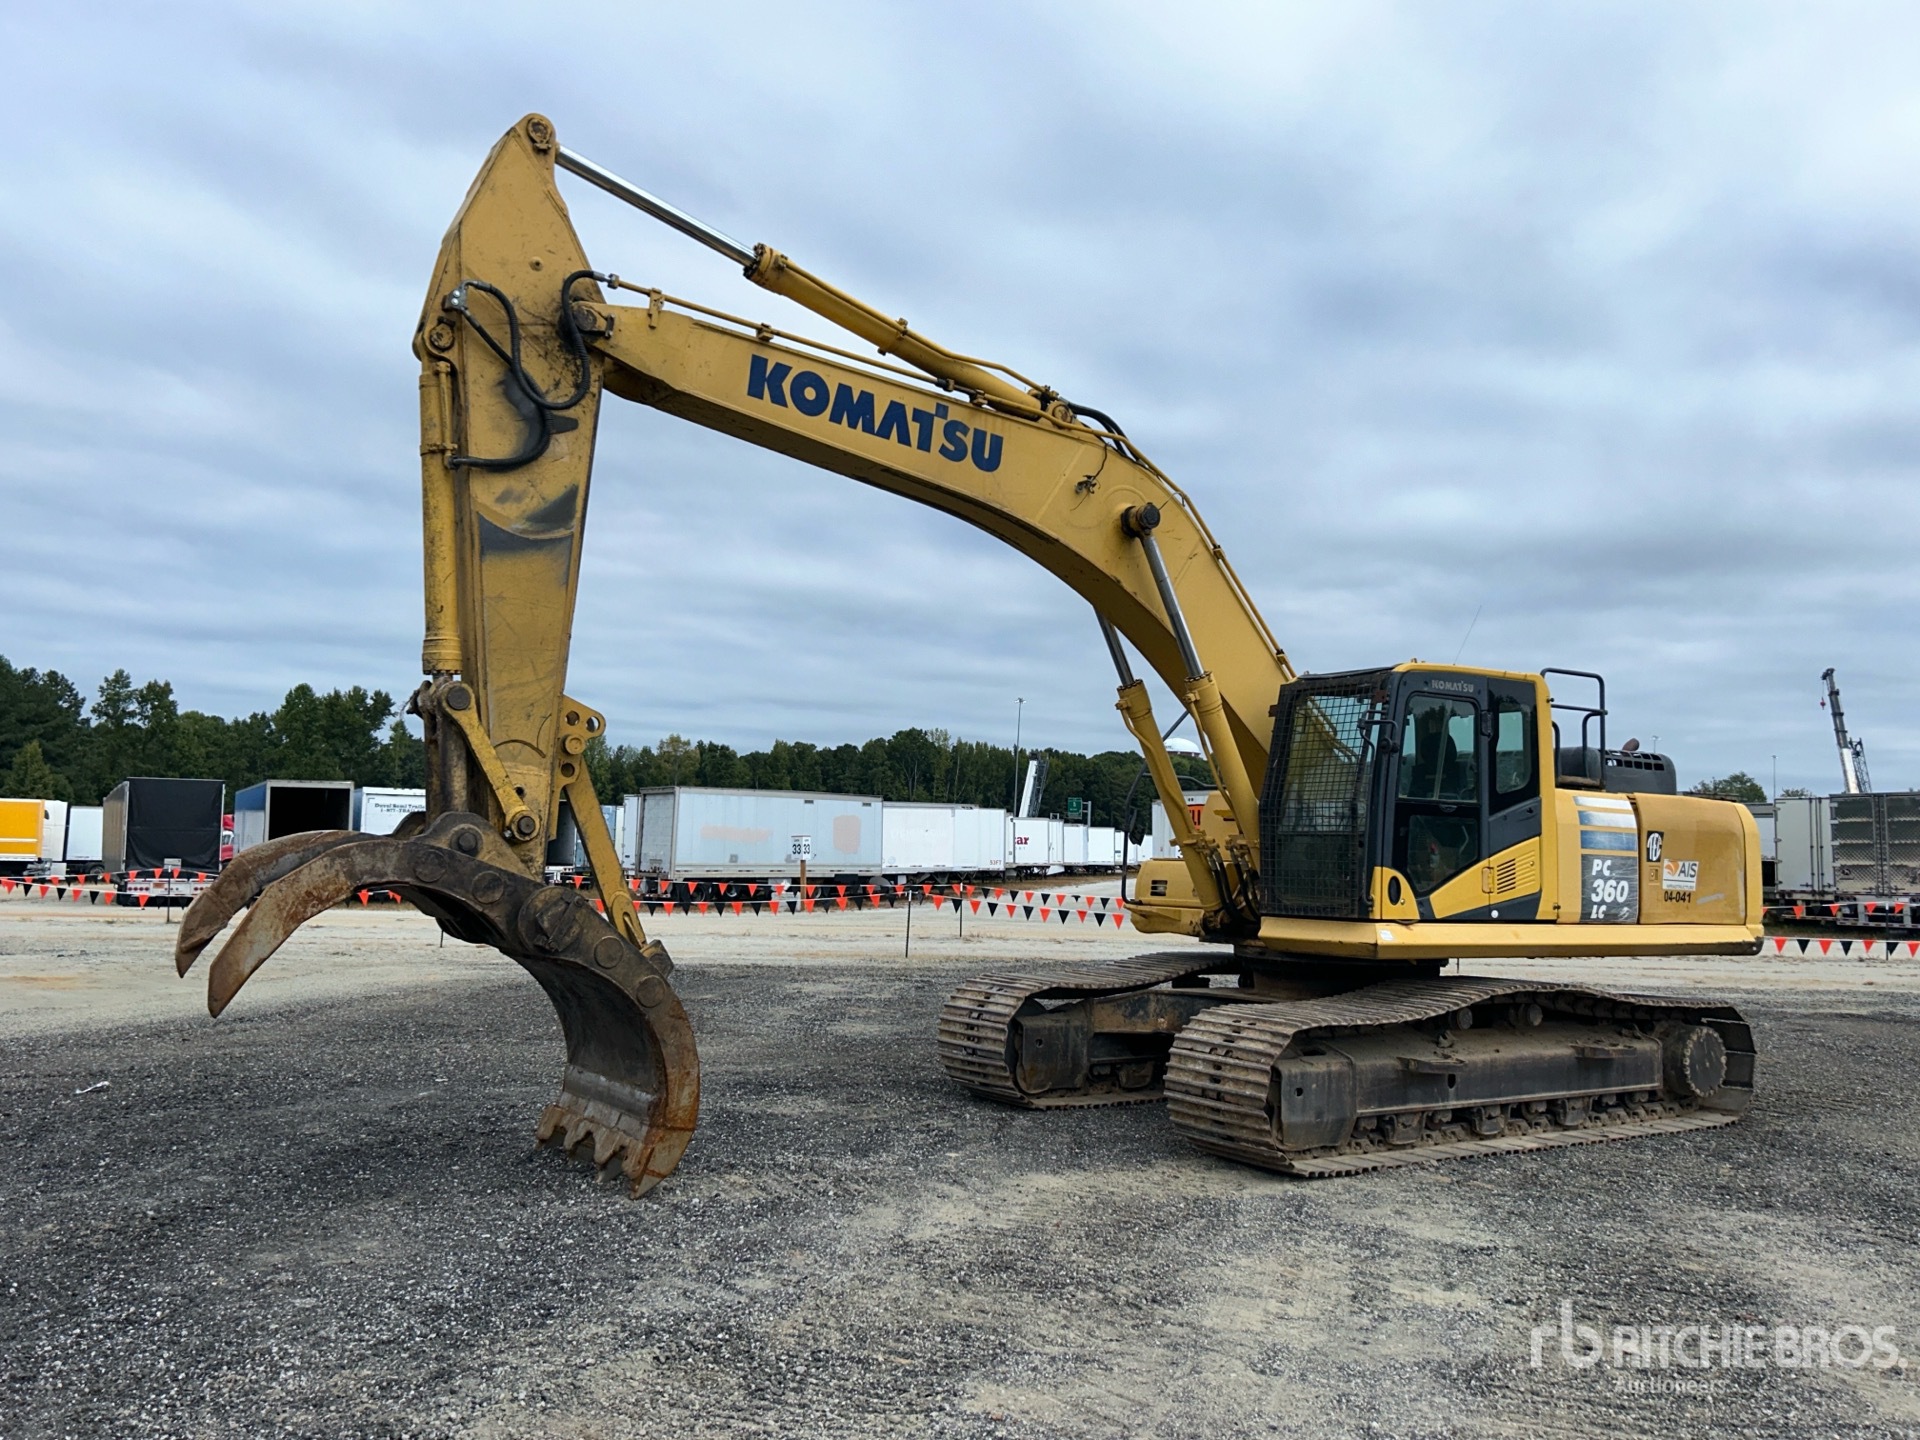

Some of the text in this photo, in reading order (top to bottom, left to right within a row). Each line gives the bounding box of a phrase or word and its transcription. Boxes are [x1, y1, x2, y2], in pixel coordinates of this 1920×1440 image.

[747, 354, 1004, 473] KOMATSU
[1432, 680, 1474, 692] KOMATSU
[792, 844, 801, 854] 33
[1591, 859, 1612, 876] PC
[1678, 862, 1697, 878] AIS
[1591, 878, 1629, 903] 360
[1664, 891, 1691, 903] 04-041
[1590, 904, 1607, 919] LC
